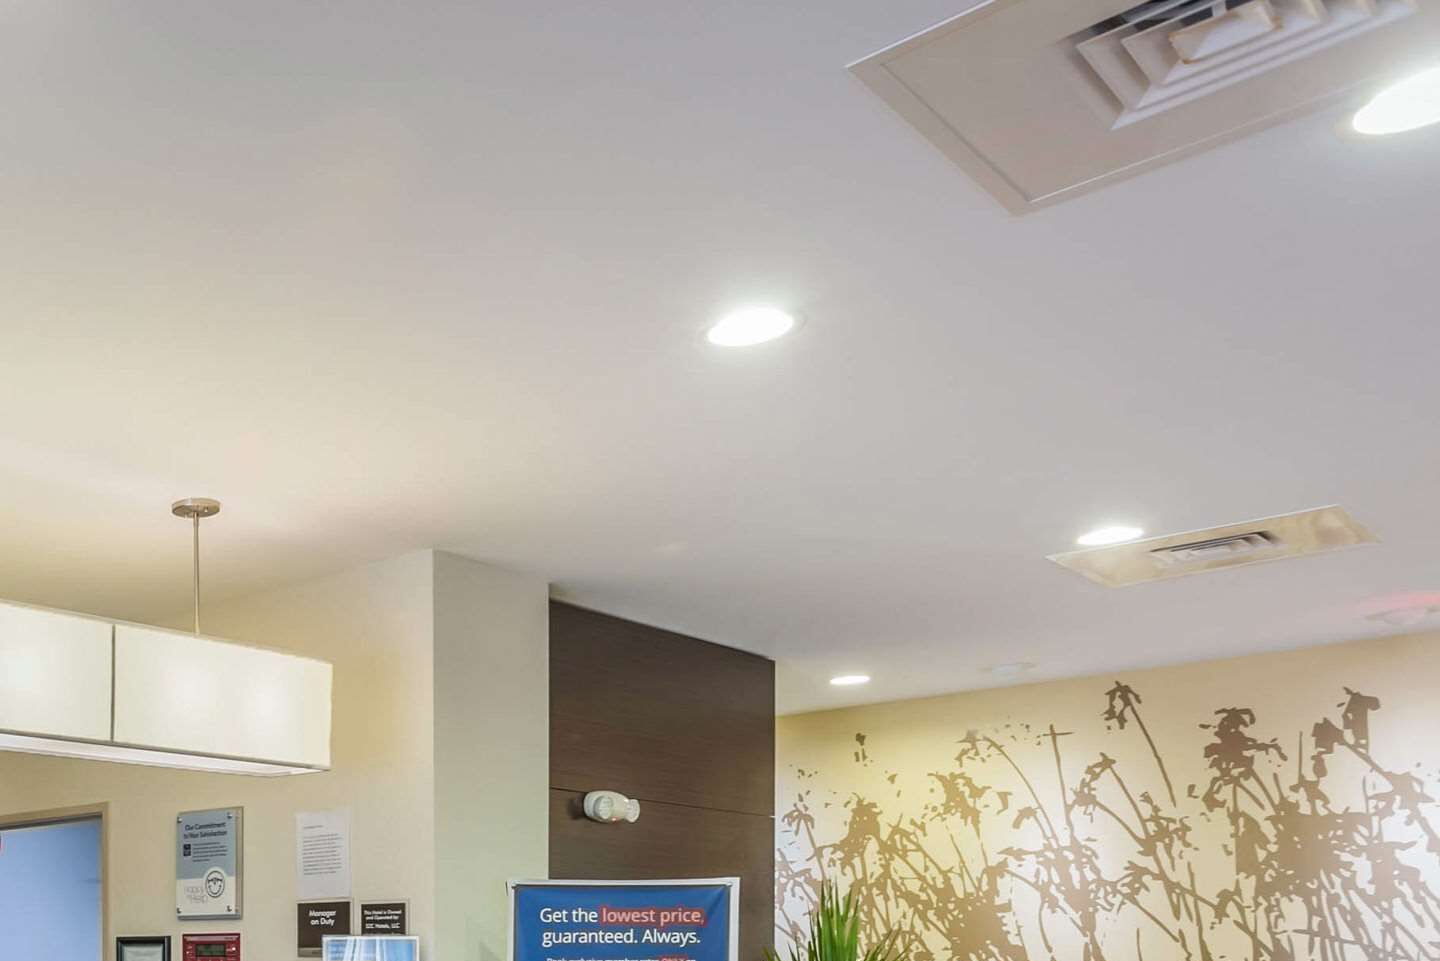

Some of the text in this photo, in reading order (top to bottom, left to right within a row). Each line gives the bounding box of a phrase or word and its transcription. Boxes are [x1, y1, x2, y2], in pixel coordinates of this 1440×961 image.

[308, 910, 337, 918] Manager
[539, 908, 705, 926] Get the lowest price,
[320, 918, 335, 926] Duty
[542, 929, 701, 947] guaranteed. Always.
